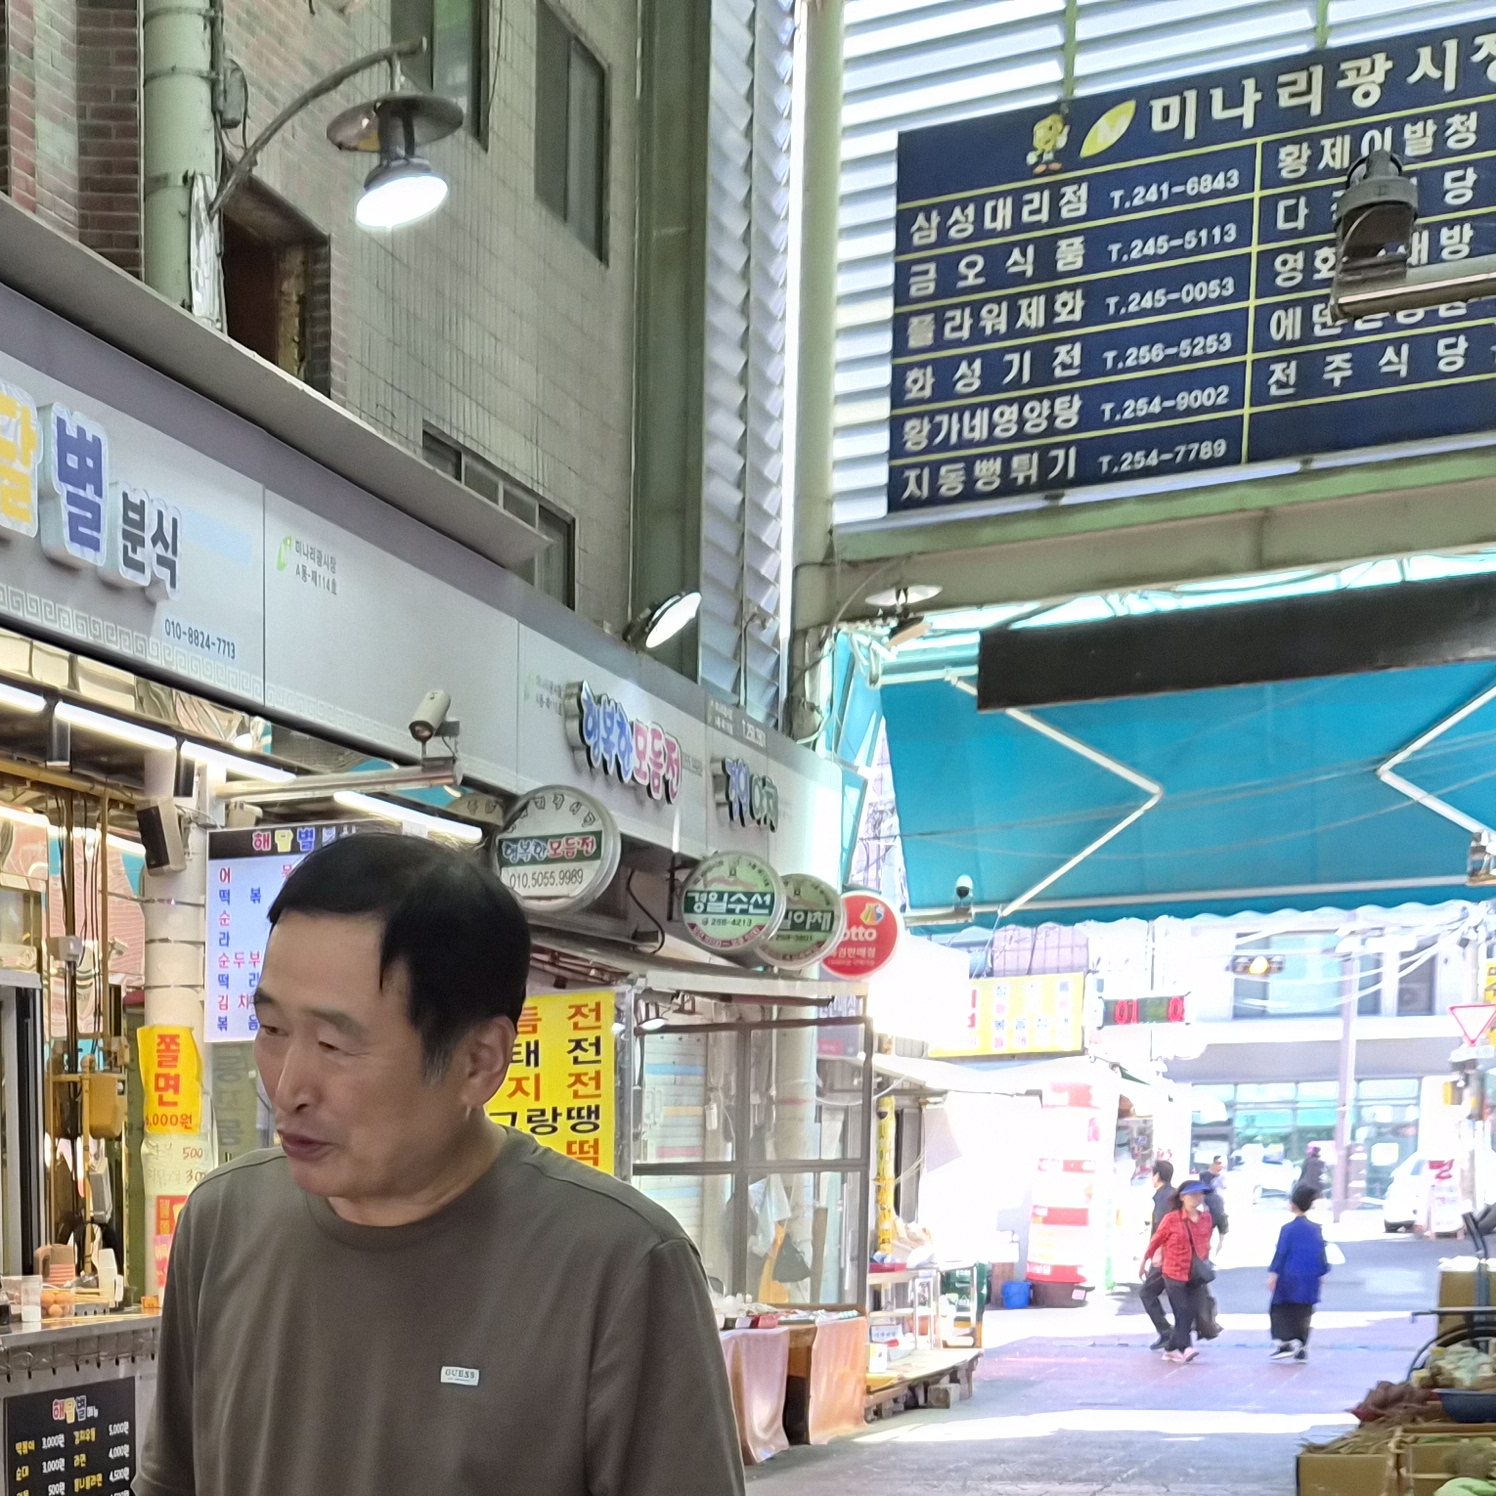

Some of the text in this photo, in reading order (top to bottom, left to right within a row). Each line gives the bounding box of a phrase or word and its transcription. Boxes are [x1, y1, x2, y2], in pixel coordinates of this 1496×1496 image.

[910, 168, 1240, 247] 삼성대리점 T.241-6843
[1107, 223, 1237, 262] T.245-5113
[1105, 277, 1235, 316] T.245-0053
[1103, 332, 1232, 370] T.256-5253
[1101, 384, 1230, 422] T.254-9002
[901, 439, 1227, 501] 지동뻥튀기 T.254-7789
[122, 490, 179, 590] 분식
[165, 618, 236, 660] 010-8824-7713
[635, 721, 681, 801] 모듬전
[502, 836, 596, 863] 행복한 모듬전
[687, 892, 771, 914] 경일수선
[154, 1033, 181, 1108] 쫄면
[48, 1481, 65, 1496] 500원
